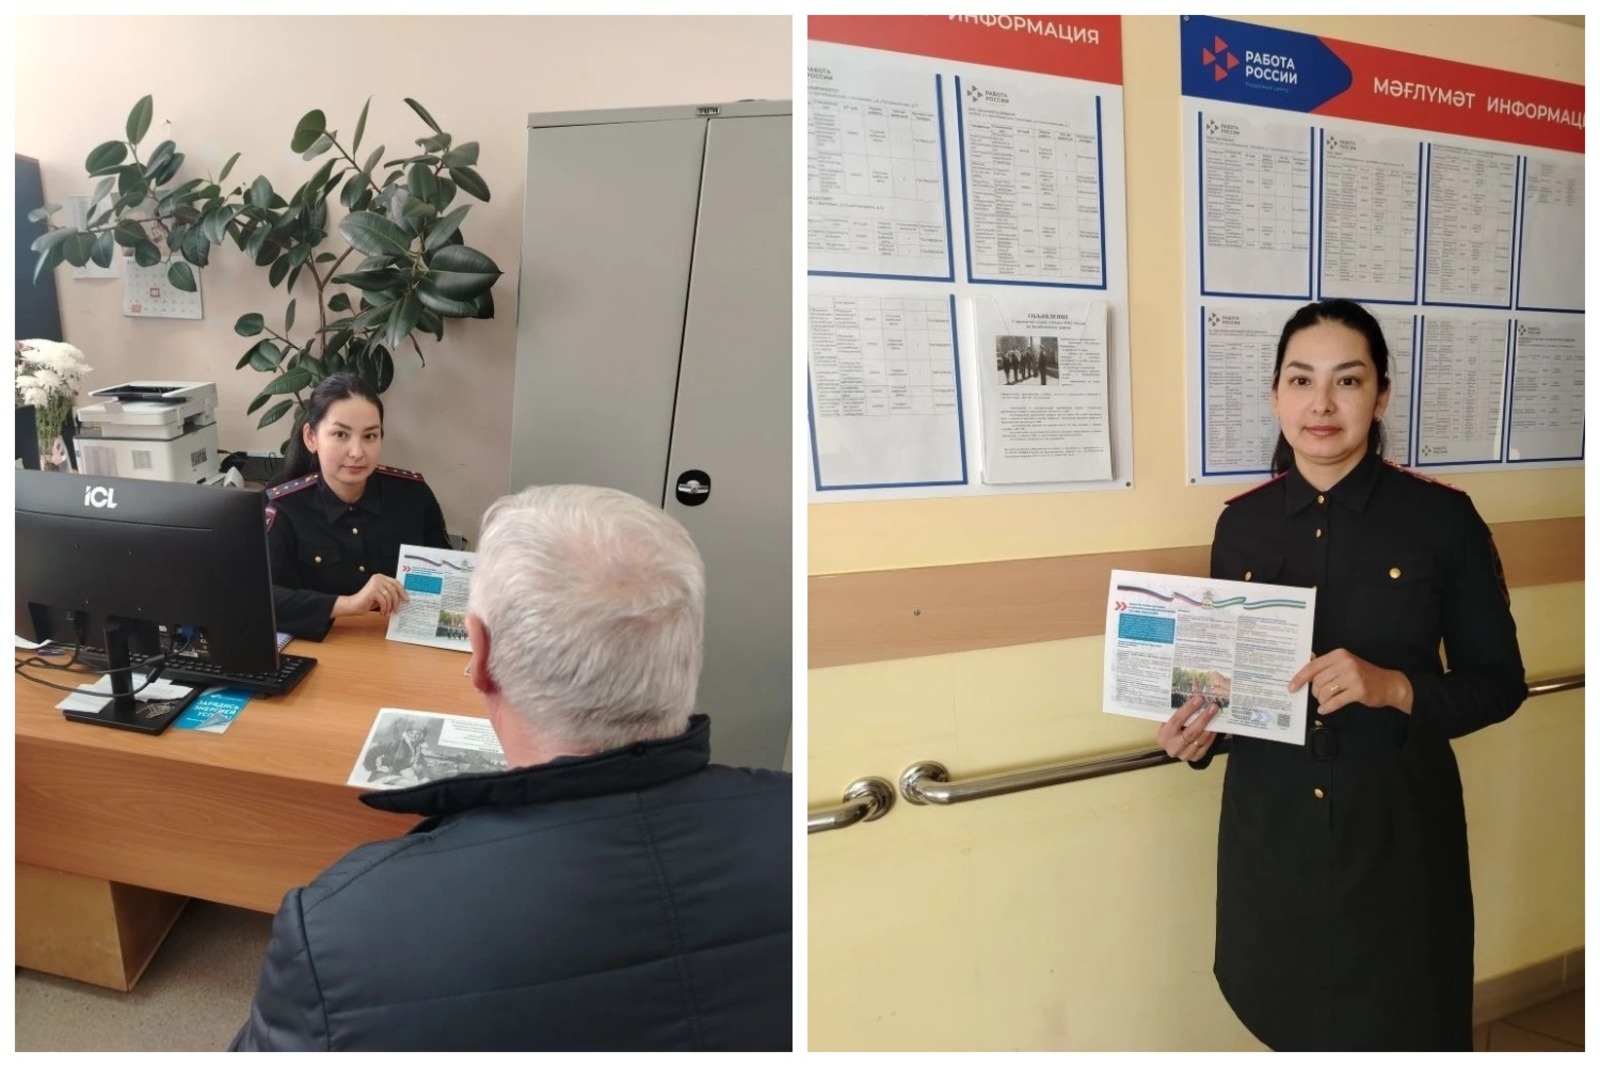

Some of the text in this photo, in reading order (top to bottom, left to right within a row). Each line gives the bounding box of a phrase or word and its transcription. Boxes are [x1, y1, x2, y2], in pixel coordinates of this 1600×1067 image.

[1245, 50, 1296, 71] РАБОТА
[1245, 65, 1298, 85] РОССИИ
[1374, 76, 1476, 109] МӘҒЛҮМӘТ
